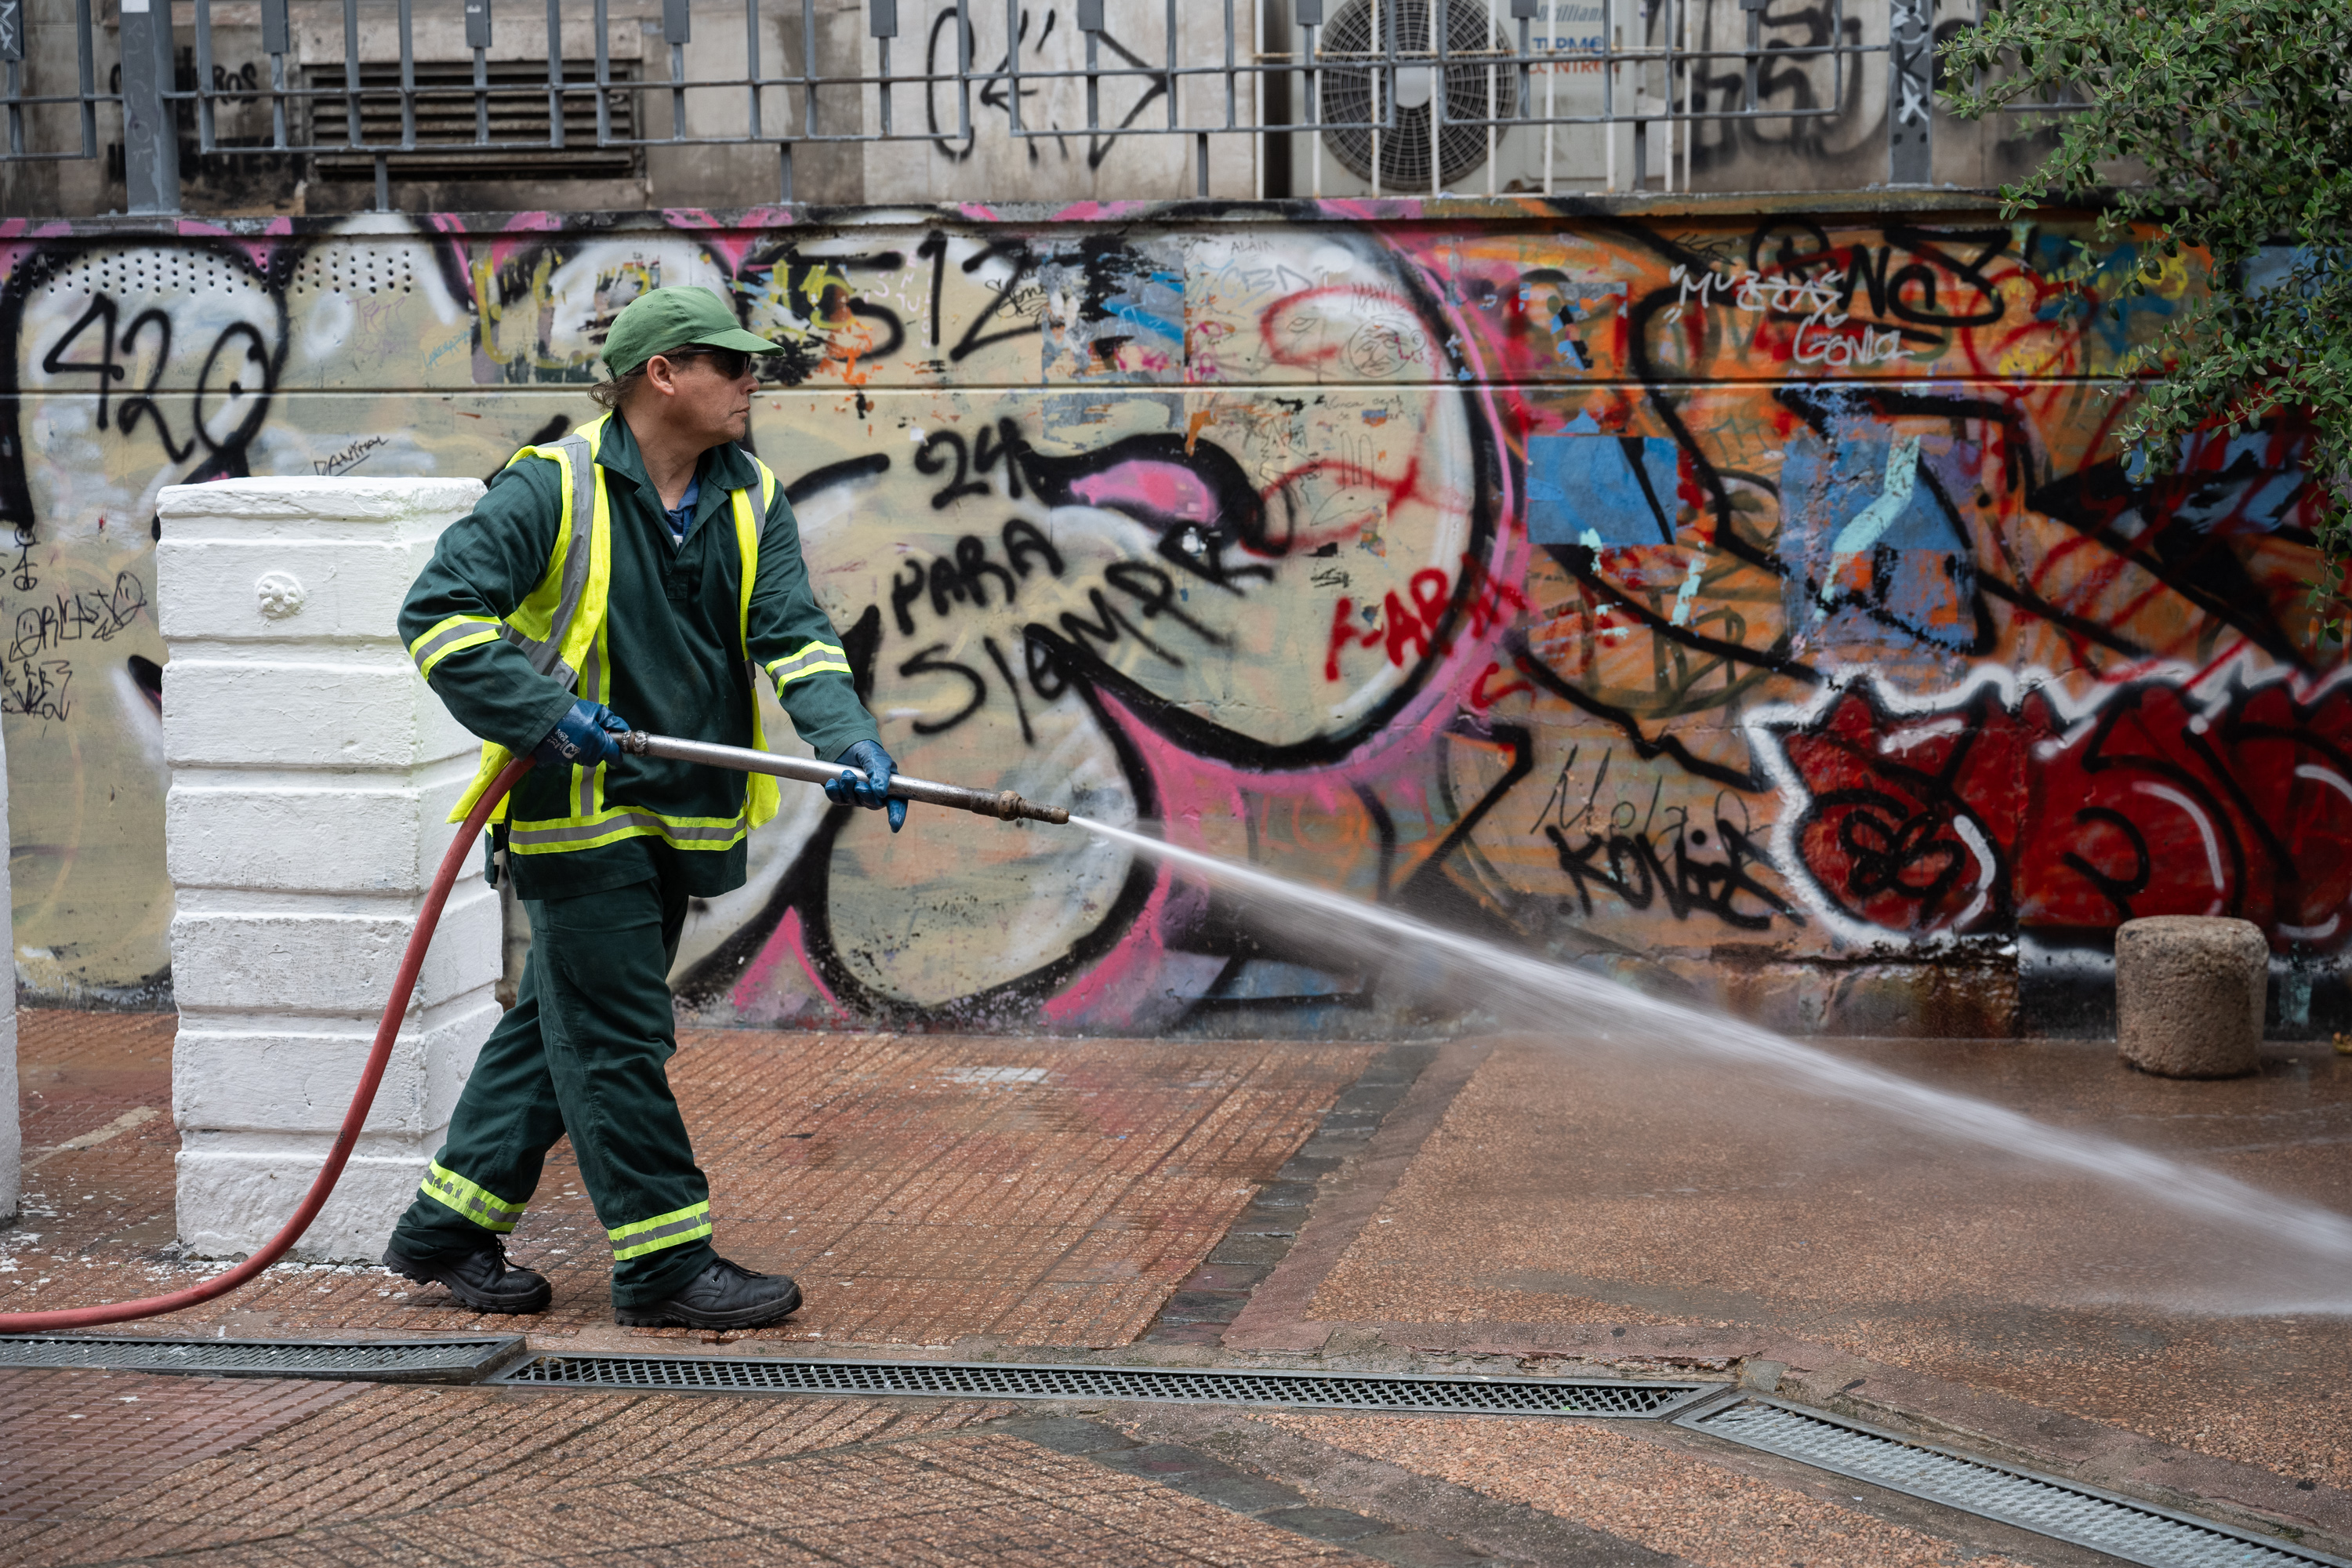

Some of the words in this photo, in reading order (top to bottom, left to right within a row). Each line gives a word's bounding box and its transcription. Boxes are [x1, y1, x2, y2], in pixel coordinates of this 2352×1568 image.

[42, 291, 274, 464] 420
[914, 416, 1030, 510] 24
[891, 517, 1065, 637] PARA
